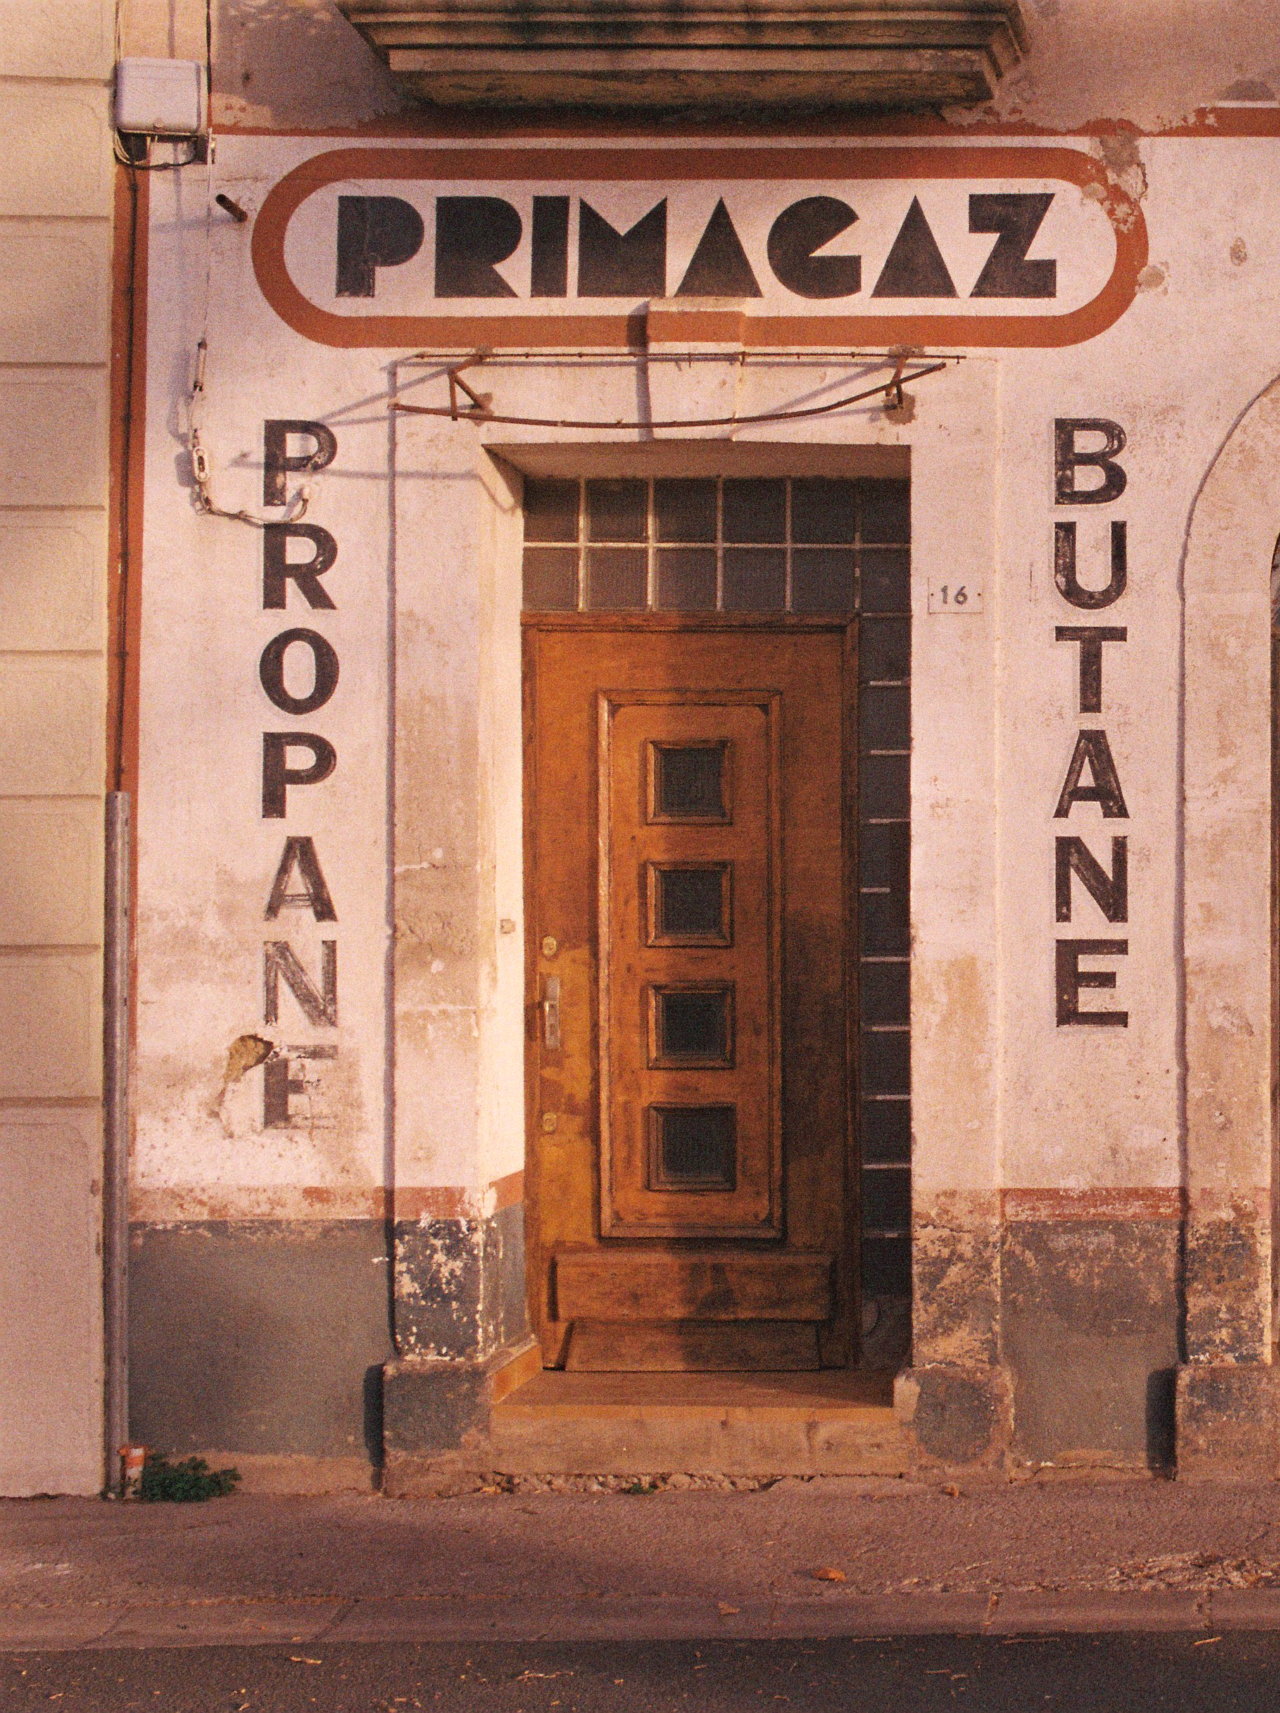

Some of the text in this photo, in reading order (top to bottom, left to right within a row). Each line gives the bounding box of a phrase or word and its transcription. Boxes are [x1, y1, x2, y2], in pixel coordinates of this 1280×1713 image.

[335, 193, 1058, 300] PRIMAGAZ
[259, 419, 340, 1129] PROPANE
[940, 585, 968, 605] 16
[1053, 418, 1130, 1028] BUTANE
